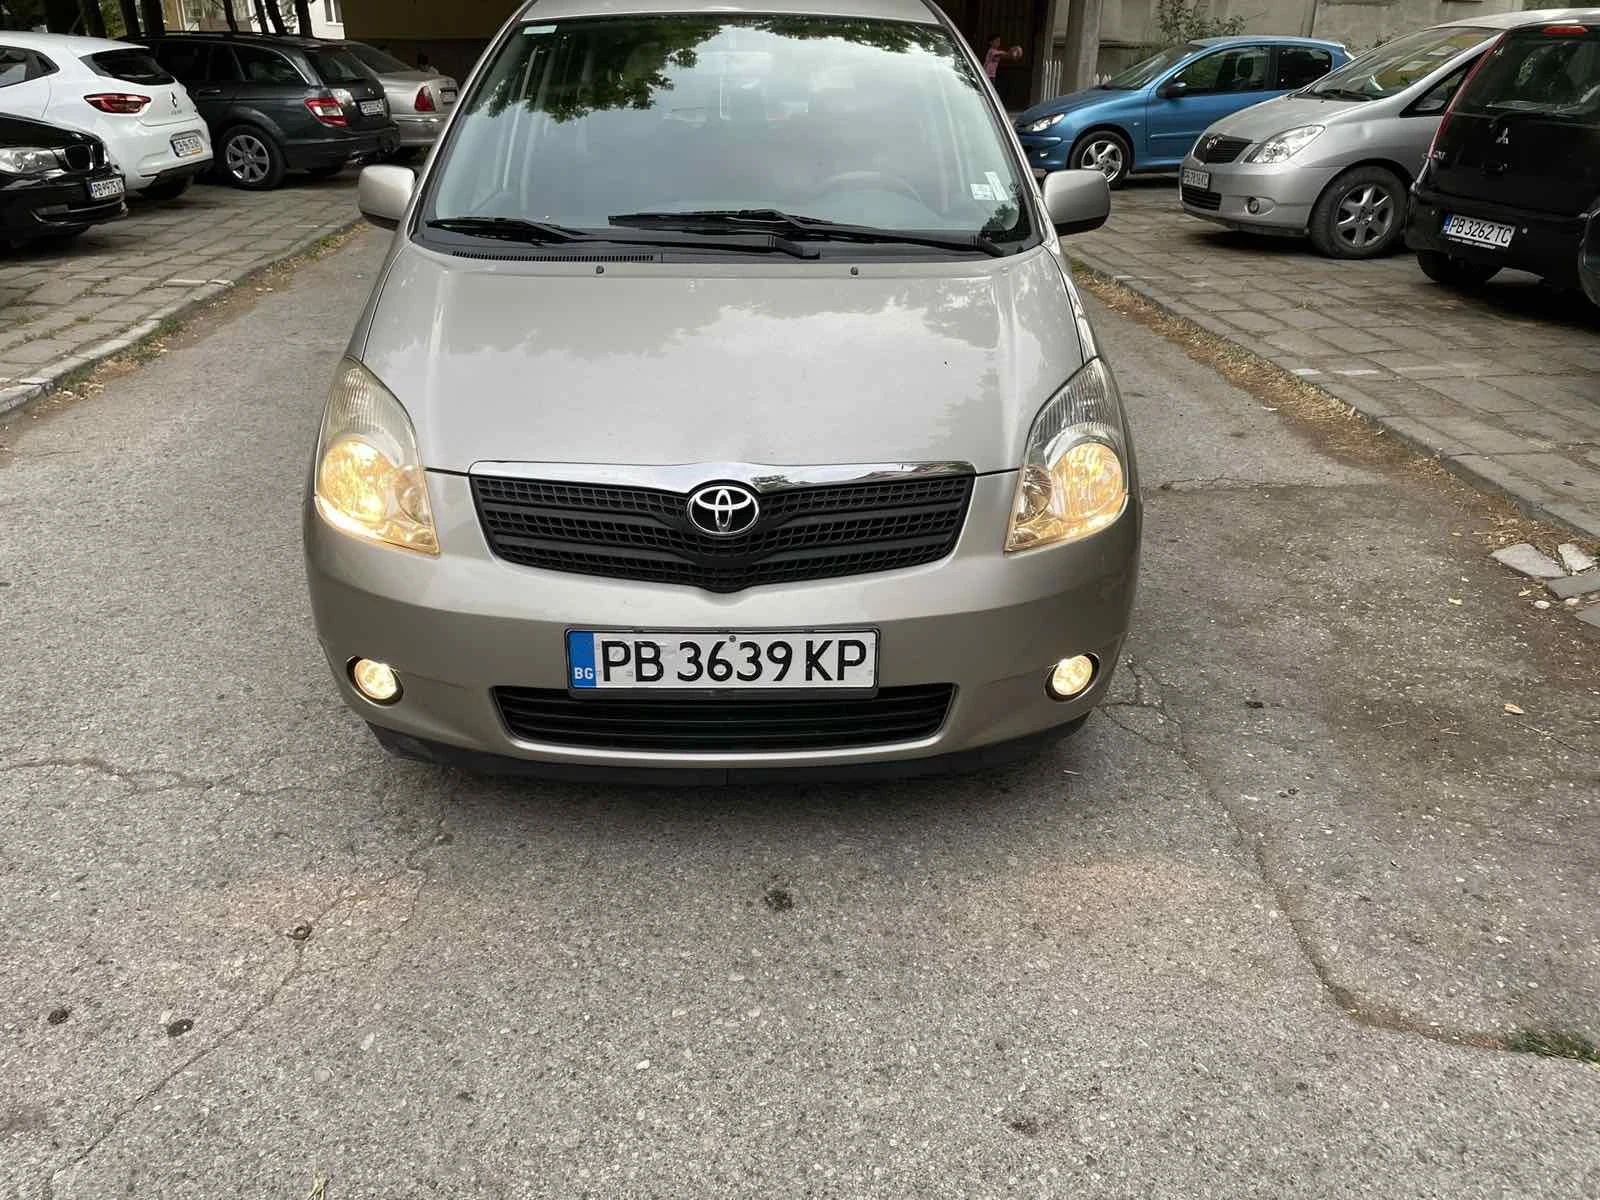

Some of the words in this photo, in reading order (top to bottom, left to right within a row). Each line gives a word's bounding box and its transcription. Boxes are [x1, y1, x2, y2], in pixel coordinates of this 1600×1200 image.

[1450, 217, 1465, 233] PB
[1464, 221, 1494, 240] 3262
[1494, 226, 1511, 243] TC
[573, 666, 594, 680] BG
[601, 639, 664, 682] PB
[677, 640, 794, 682] 3639
[804, 639, 868, 682] KP
